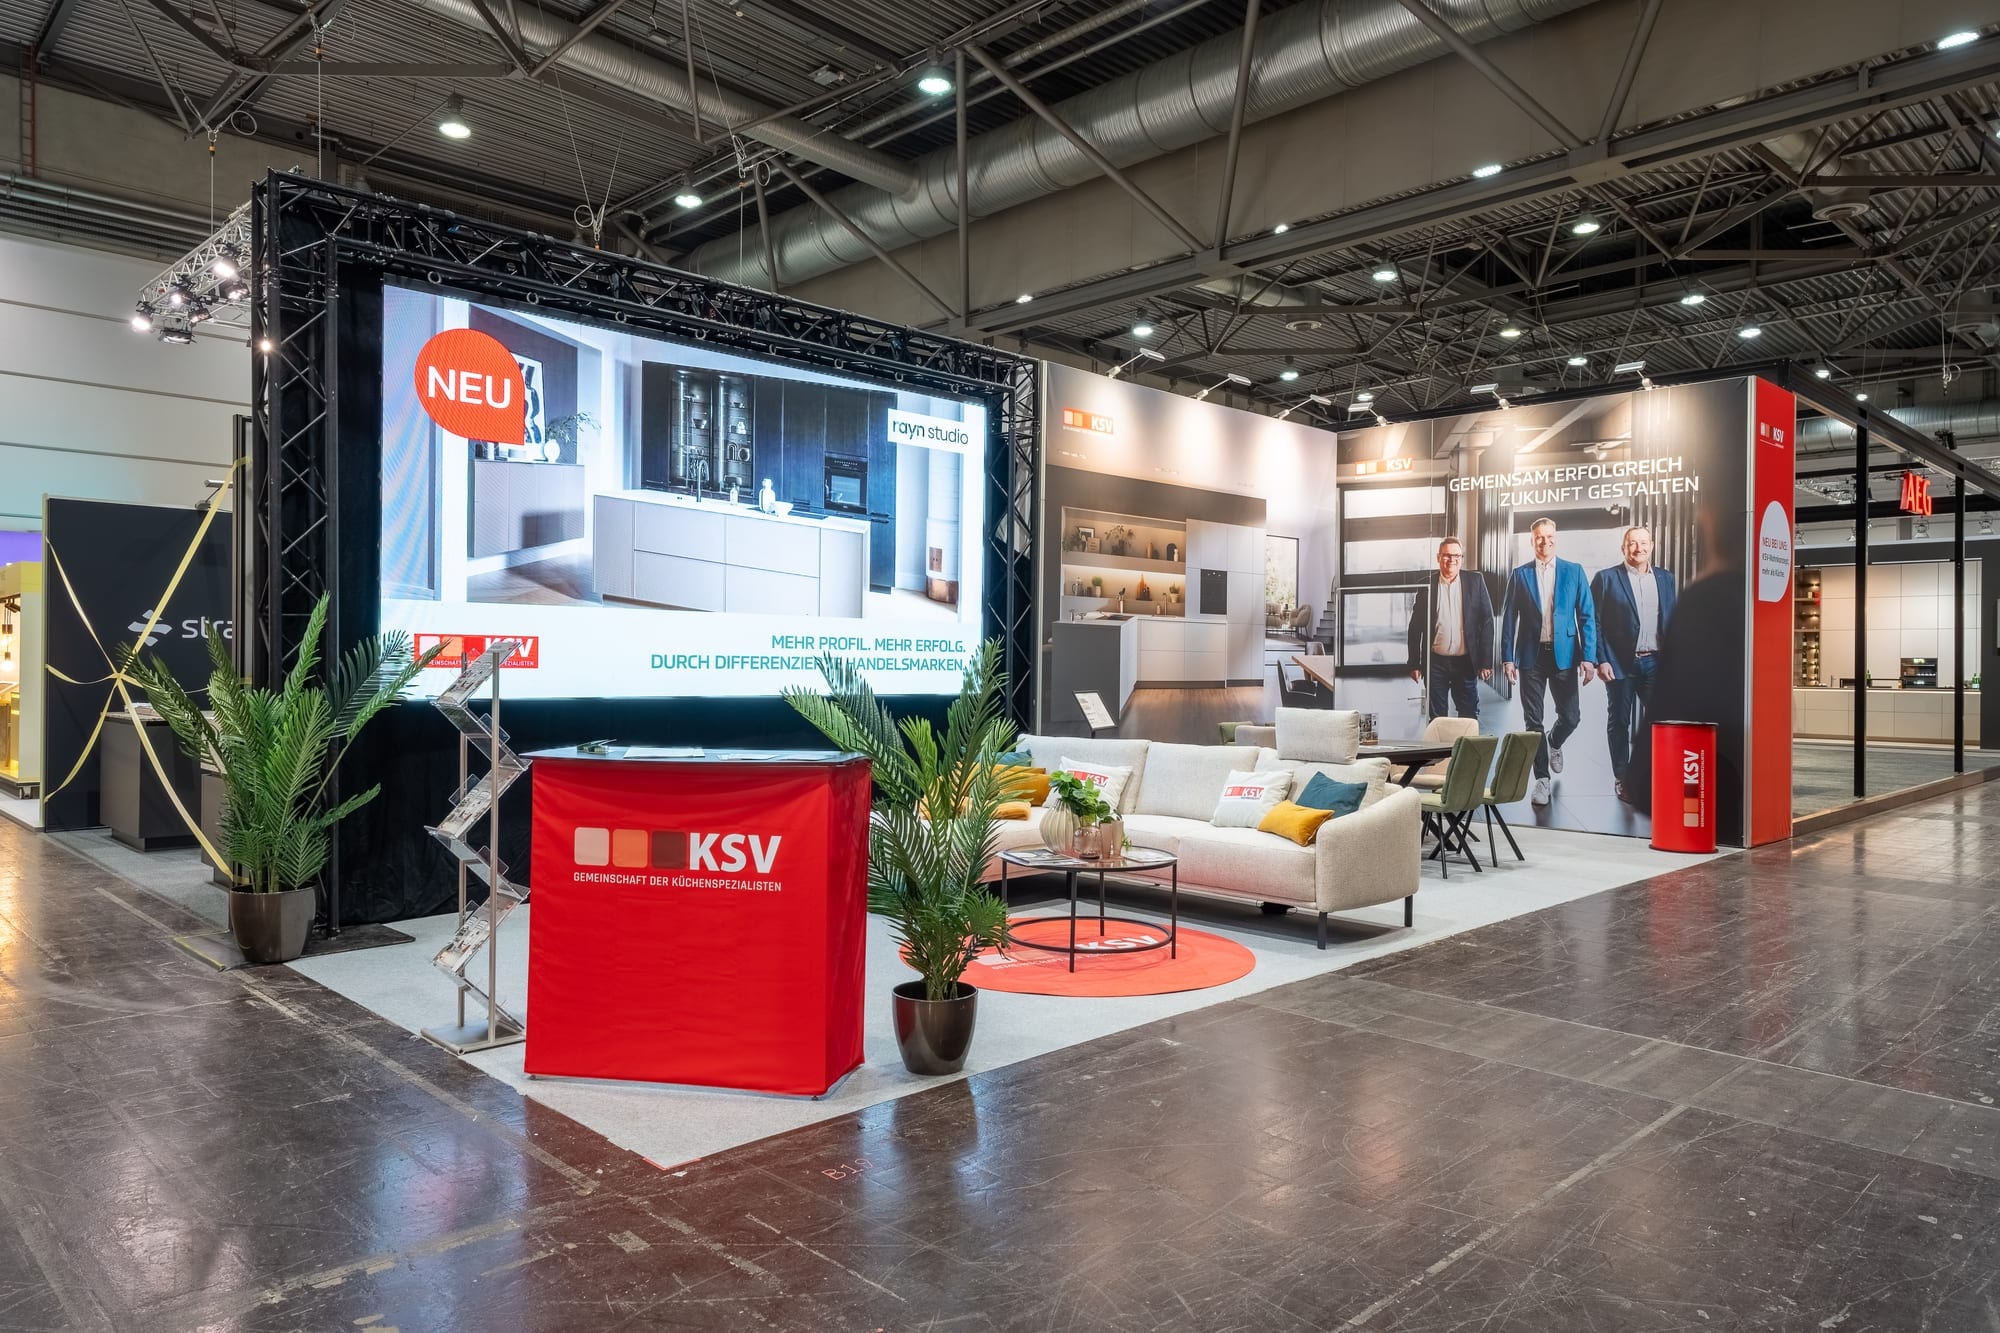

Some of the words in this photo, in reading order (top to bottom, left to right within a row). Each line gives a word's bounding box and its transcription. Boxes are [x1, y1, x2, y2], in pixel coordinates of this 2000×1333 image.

[428, 365, 511, 409] NEU
[893, 420, 925, 441] rayn
[928, 425, 968, 445] studio
[1091, 415, 1113, 433] KSV
[1773, 427, 1784, 443] KSV
[1386, 457, 1412, 471] KSV
[1449, 468, 1549, 492] GEMEINSAM
[1554, 455, 1683, 483] ERFOLGREICH
[1500, 486, 1583, 507] ZUKUNFT
[1588, 475, 1699, 499] GESTALTEN
[1902, 472, 1932, 516] AEG
[771, 635, 815, 650] MEHR
[819, 637, 871, 651] PROFIL.
[875, 638, 912, 652] MEHR
[916, 640, 966, 653] ERFOLG.
[651, 654, 710, 669] DURCH
[1683, 750, 1699, 784] KSV
[1086, 773, 1109, 786] KSV
[1241, 787, 1264, 798] KSV
[690, 832, 782, 874] KSV
[573, 872, 647, 885] GEMEINSCHAFT
[650, 875, 669, 886] DER
[671, 876, 782, 892] KÜCHENSPEZIALISTEN
[821, 1158, 873, 1180] B19
